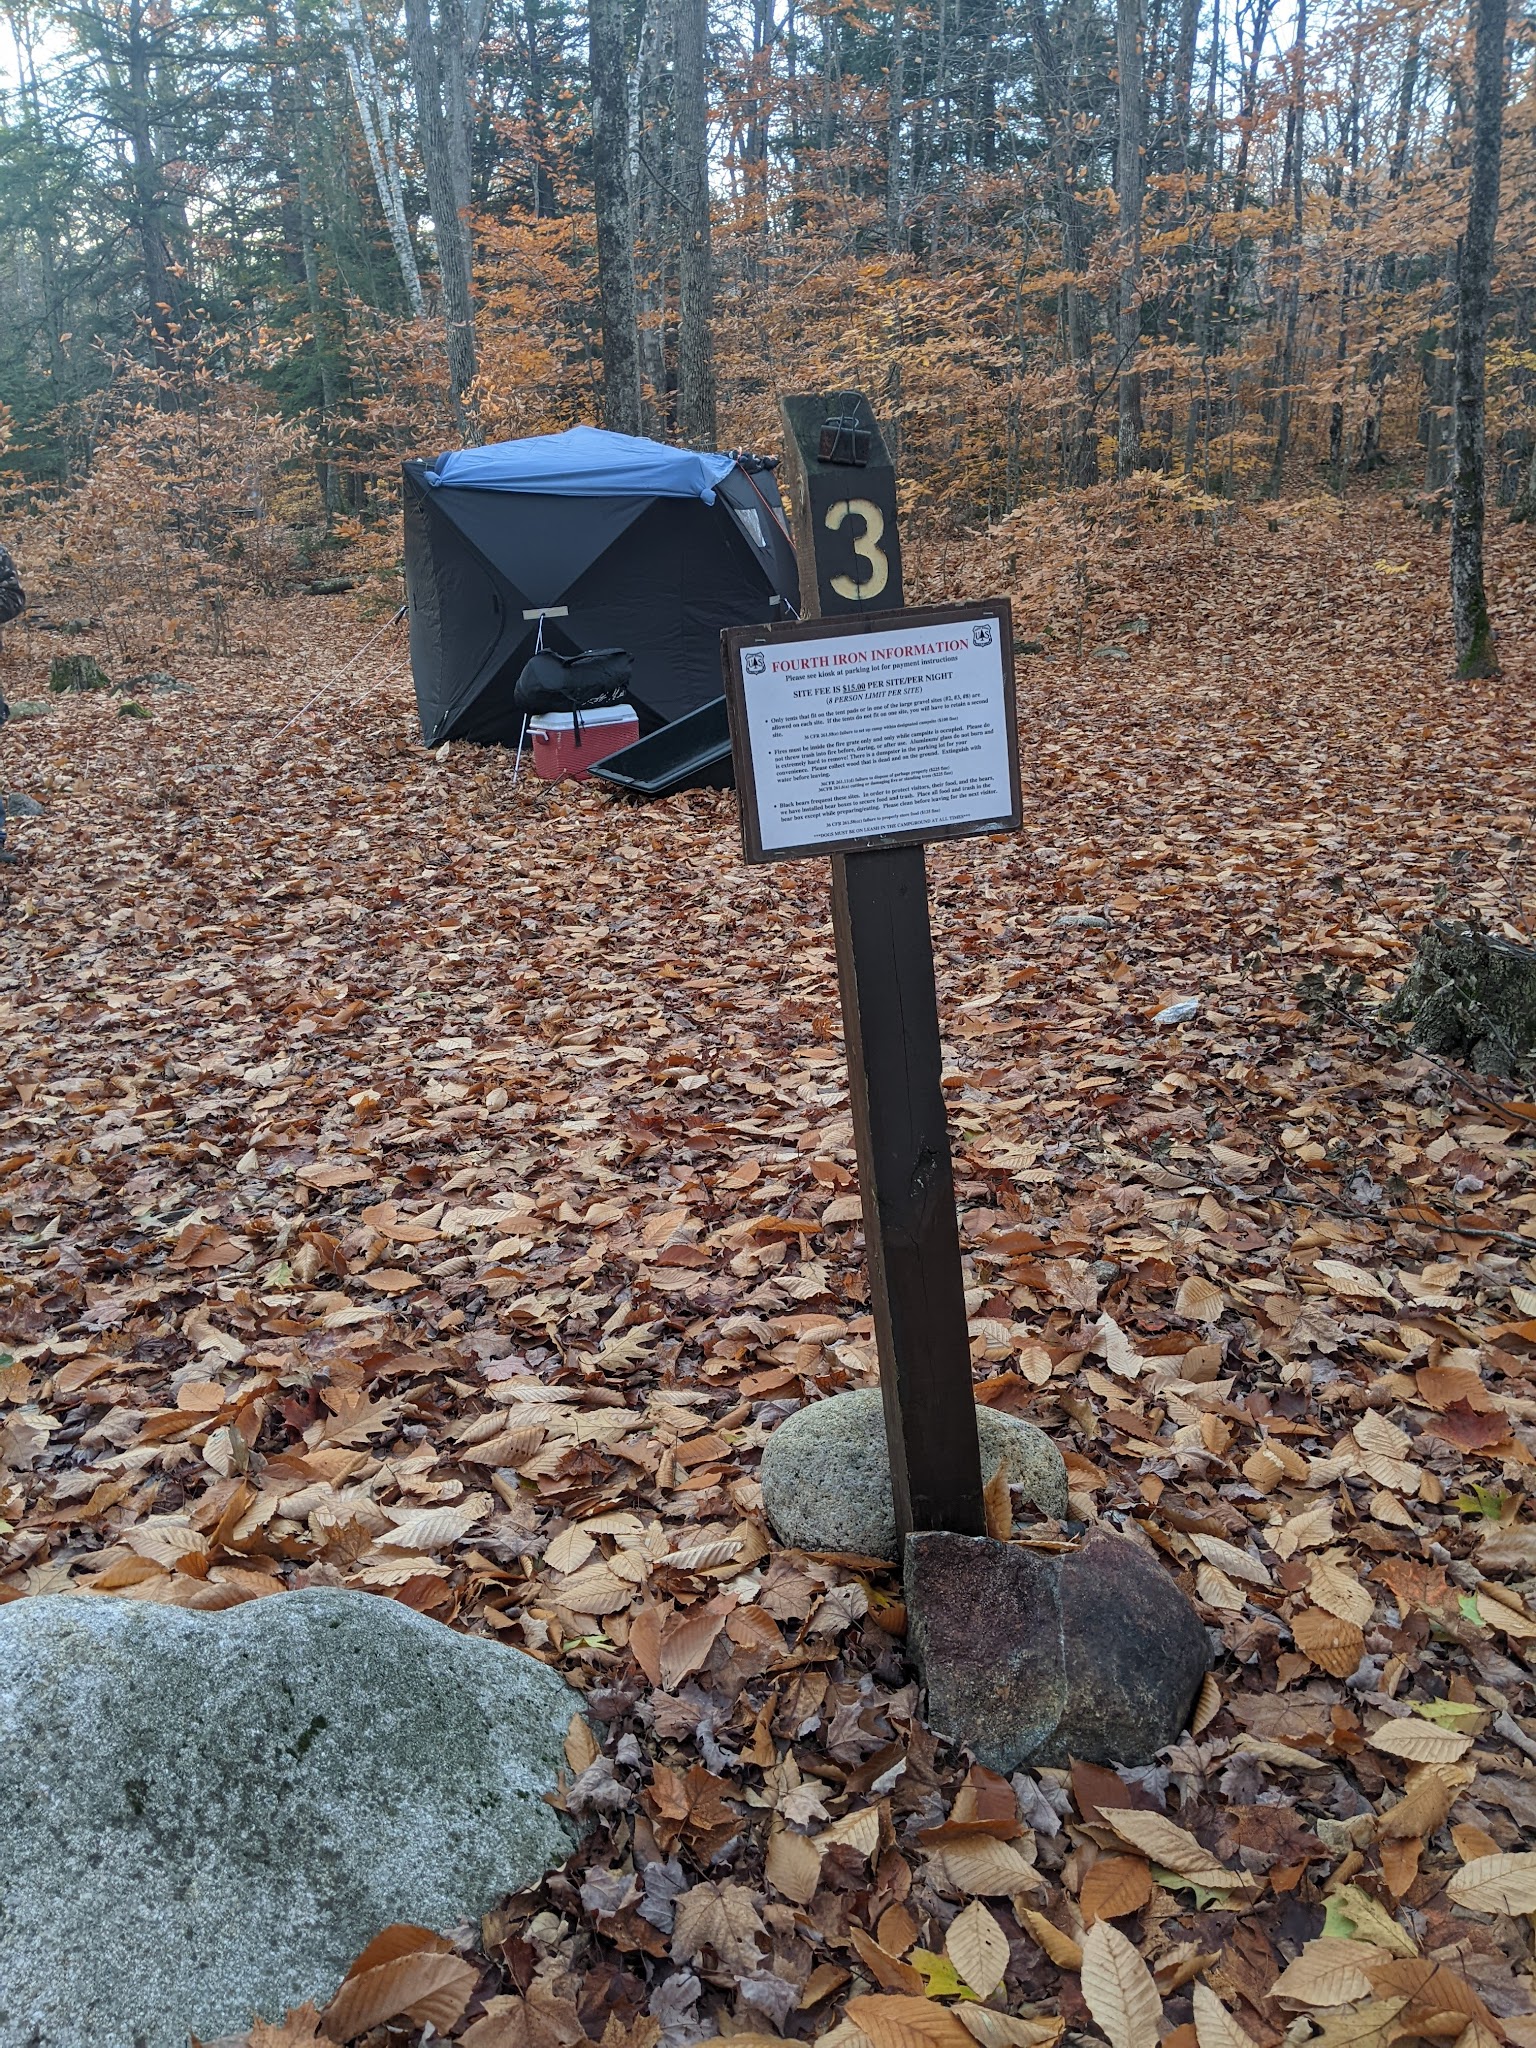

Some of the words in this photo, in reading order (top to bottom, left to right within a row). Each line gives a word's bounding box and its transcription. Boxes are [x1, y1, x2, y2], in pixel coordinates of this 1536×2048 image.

[825, 499, 888, 600] 3
[772, 655, 829, 672] FOURTH
[832, 651, 867, 665] IRON
[870, 638, 969, 660] INFORMATION
[785, 673, 805, 681] Please
[817, 669, 835, 678] kiosk
[844, 665, 870, 676] parking
[881, 662, 891, 670] for
[892, 660, 919, 670] payment
[921, 654, 958, 665] instructions
[793, 688, 812, 698] SITE
[814, 686, 831, 695] FEE
[832, 685, 840, 693] IS
[842, 682, 866, 694] $15.00
[867, 680, 884, 689] PER
[885, 675, 923, 686] SITE/PER
[925, 671, 953, 681] NIGHT
[825, 697, 833, 705] (8
[833, 693, 863, 703] PERSON
[864, 690, 886, 699] LIMIT
[887, 688, 901, 696] PER
[903, 686, 922, 695] SITE)
